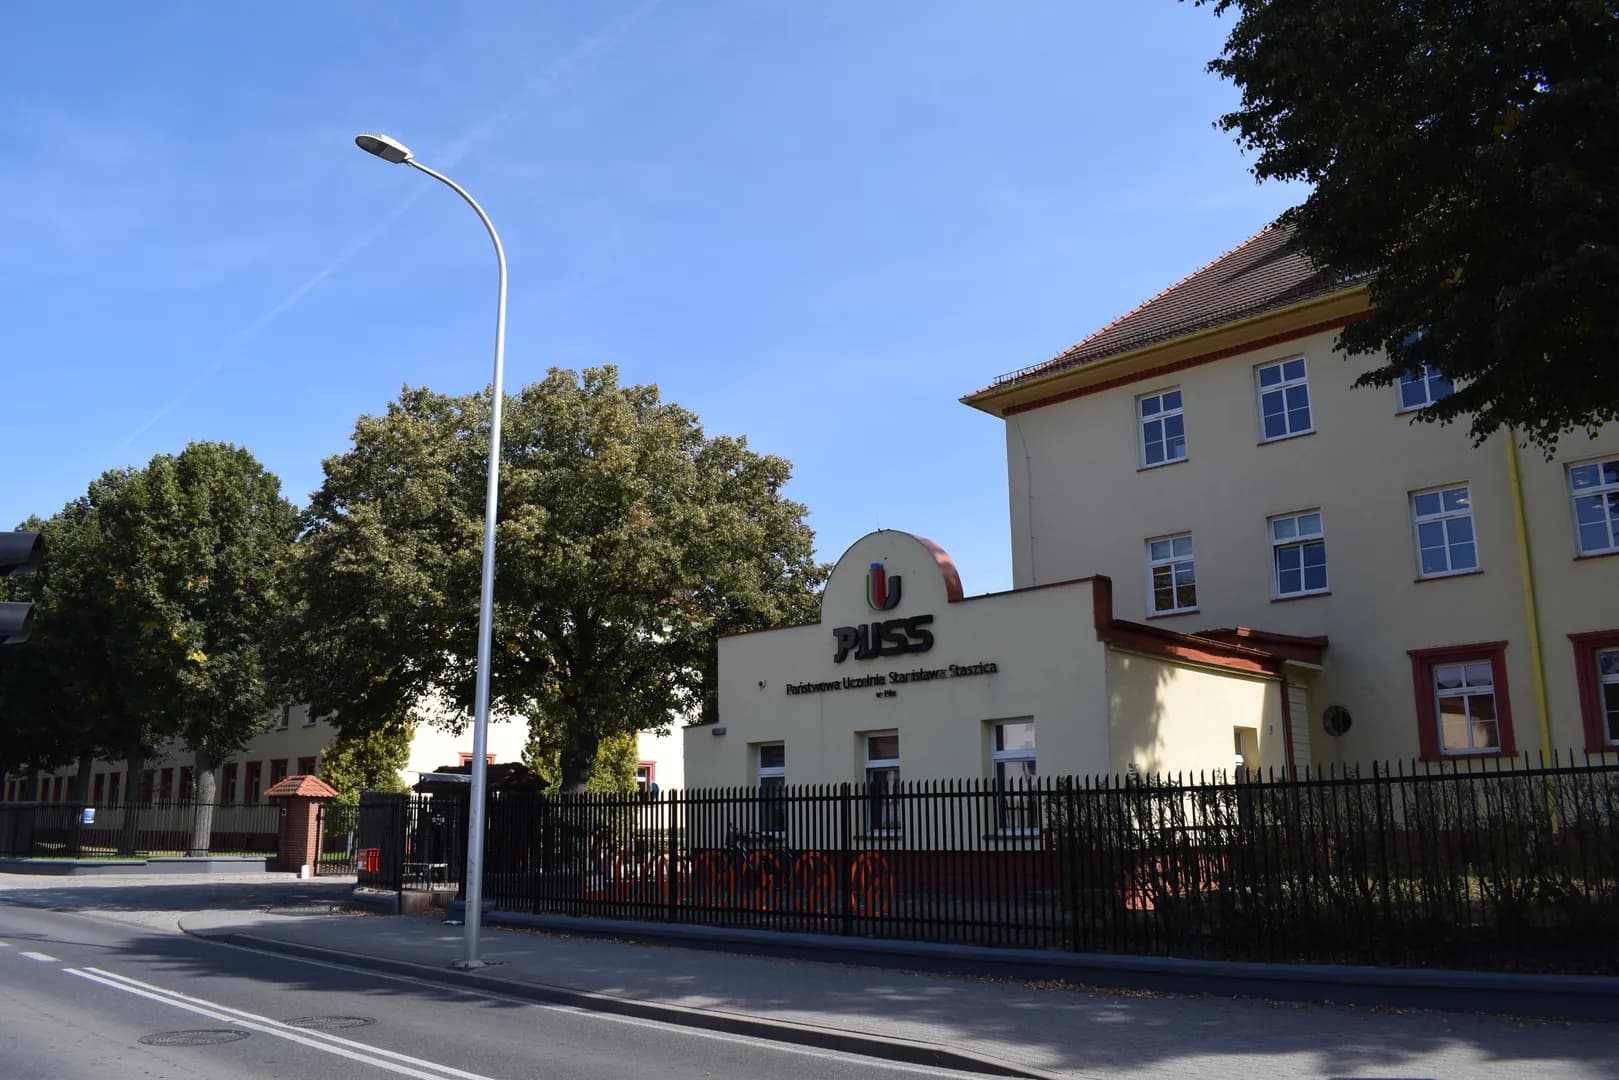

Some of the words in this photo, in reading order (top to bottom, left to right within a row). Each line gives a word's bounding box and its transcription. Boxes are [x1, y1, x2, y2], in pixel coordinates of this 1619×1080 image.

[833, 614, 934, 663] PUSS
[842, 674, 885, 689] Uczelnia
[948, 661, 998, 678] Staszica
